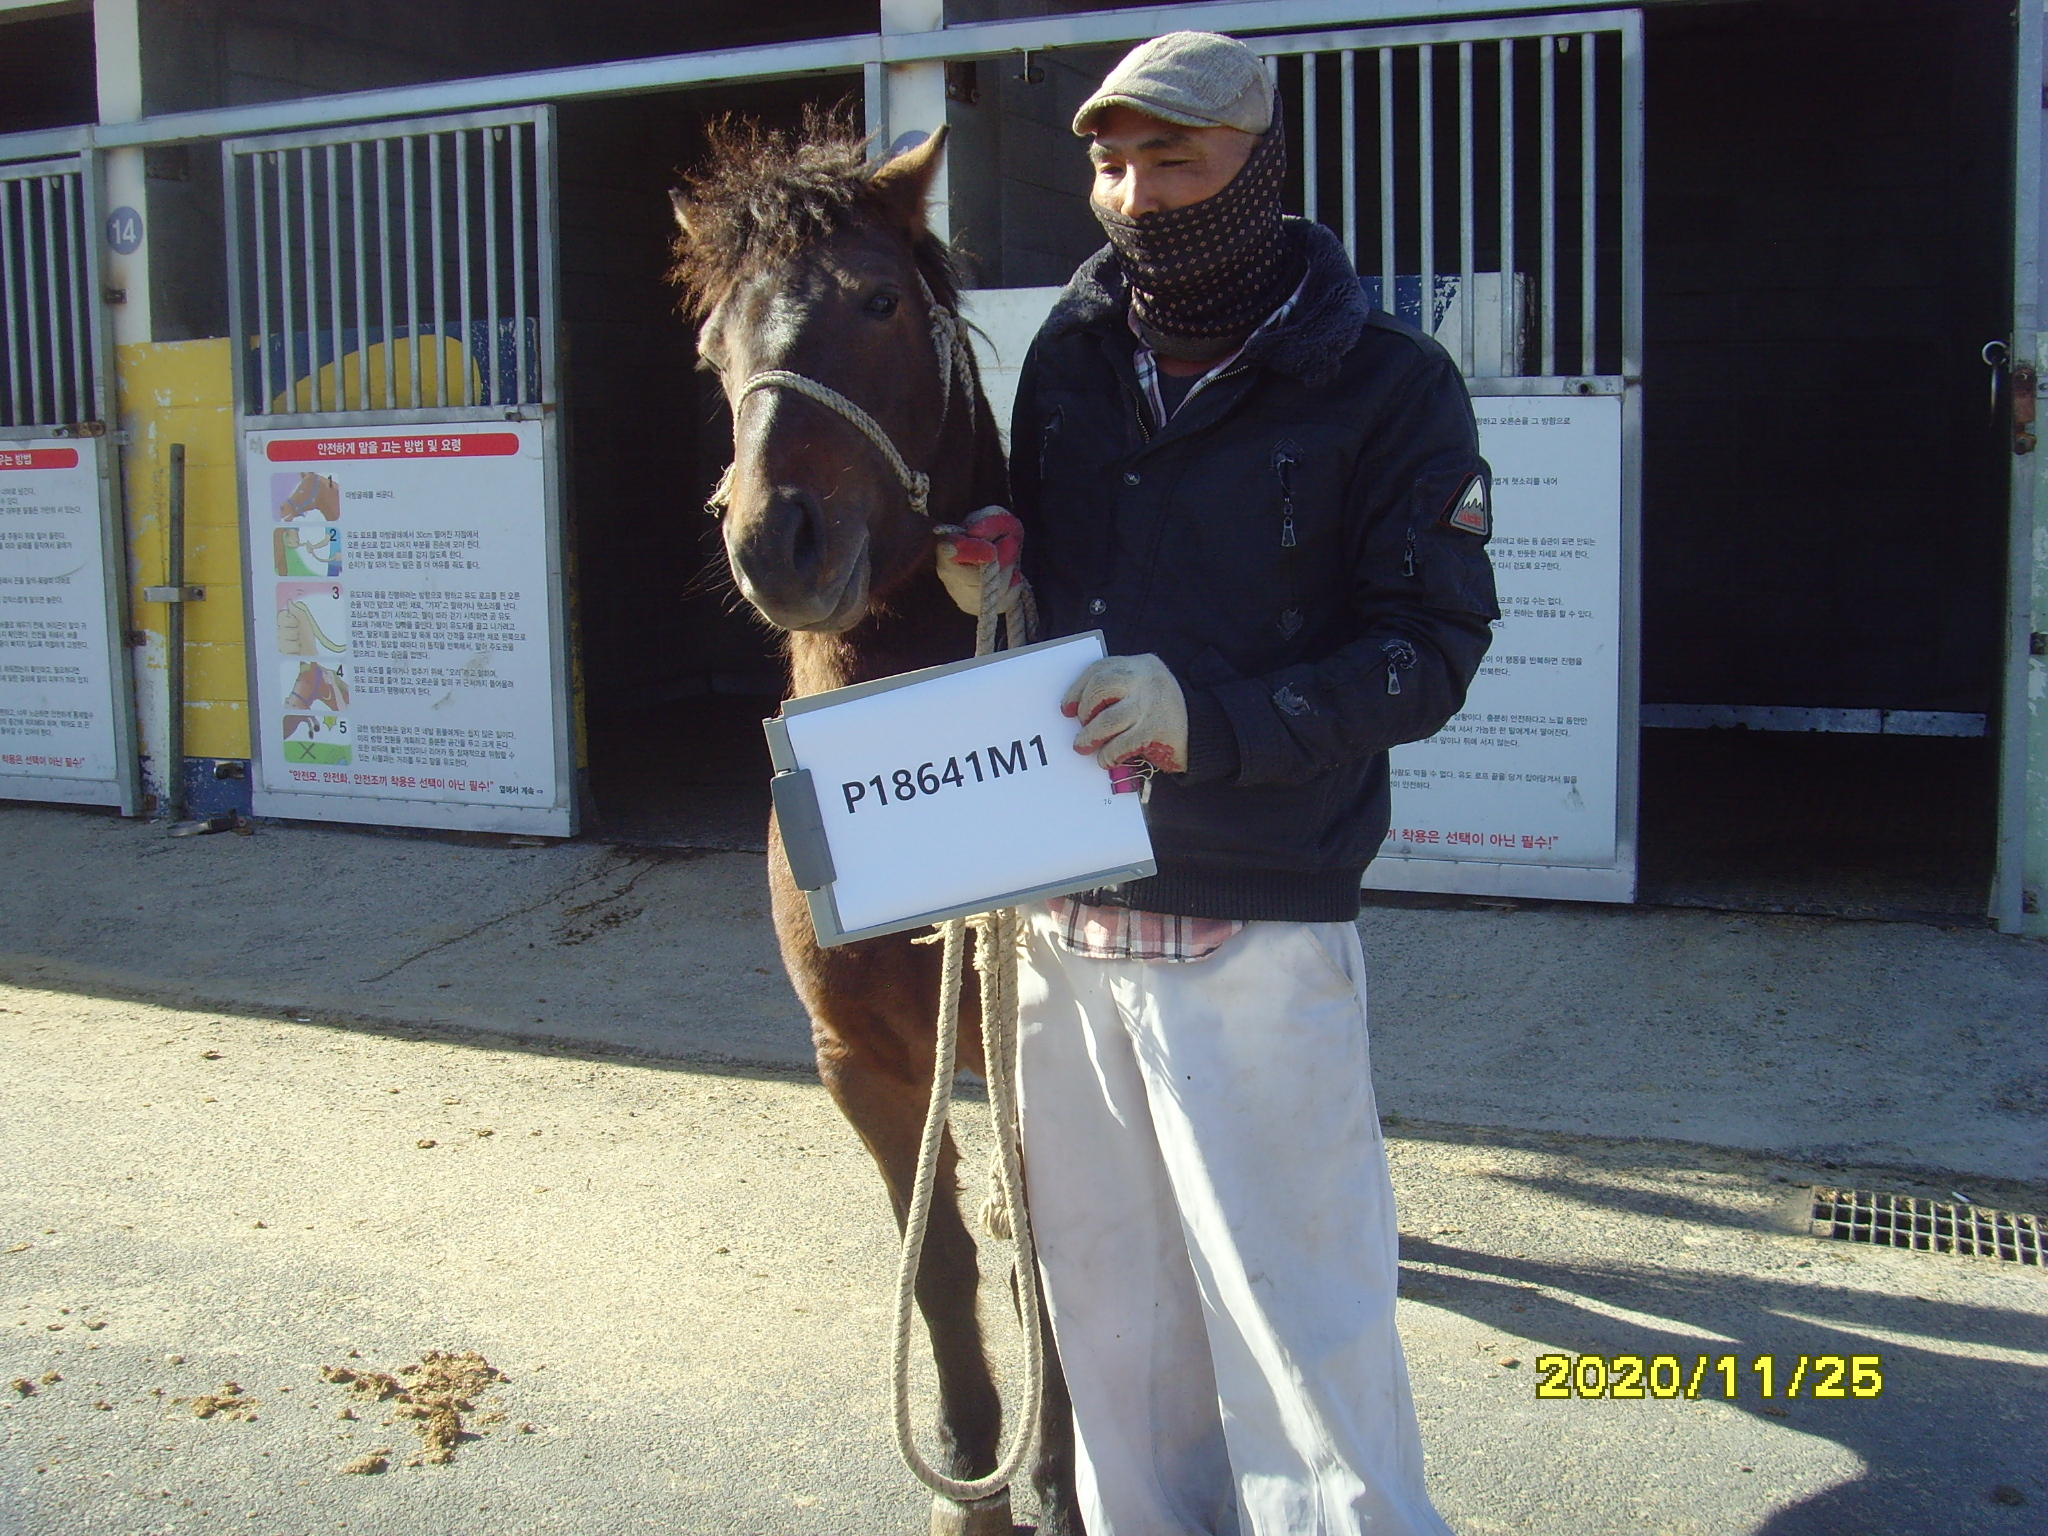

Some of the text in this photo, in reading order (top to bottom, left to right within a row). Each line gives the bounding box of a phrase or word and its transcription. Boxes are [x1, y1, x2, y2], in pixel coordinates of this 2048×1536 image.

[112, 217, 136, 244] 14
[317, 439, 461, 455] 안전하게 말을 끄는 방법 및 요령
[14, 453, 32, 465] 방법
[327, 475, 334, 488] 1
[329, 529, 337, 542] 2
[332, 587, 340, 600] 3
[336, 665, 344, 677] 4
[339, 722, 347, 734] 5
[1, 753, 23, 766] 착용은
[25, 754, 47, 767] 선택이
[48, 755, 63, 768] 아닌
[842, 734, 1048, 814] P18641M1
[353, 773, 388, 787] 안전조끼
[390, 775, 416, 789] 착용은
[420, 776, 445, 791] 선택이
[448, 778, 466, 792] 아닌
[1402, 829, 1439, 844] 착용은
[1446, 831, 1484, 846] 선택이
[1489, 833, 1515, 848] 아닌
